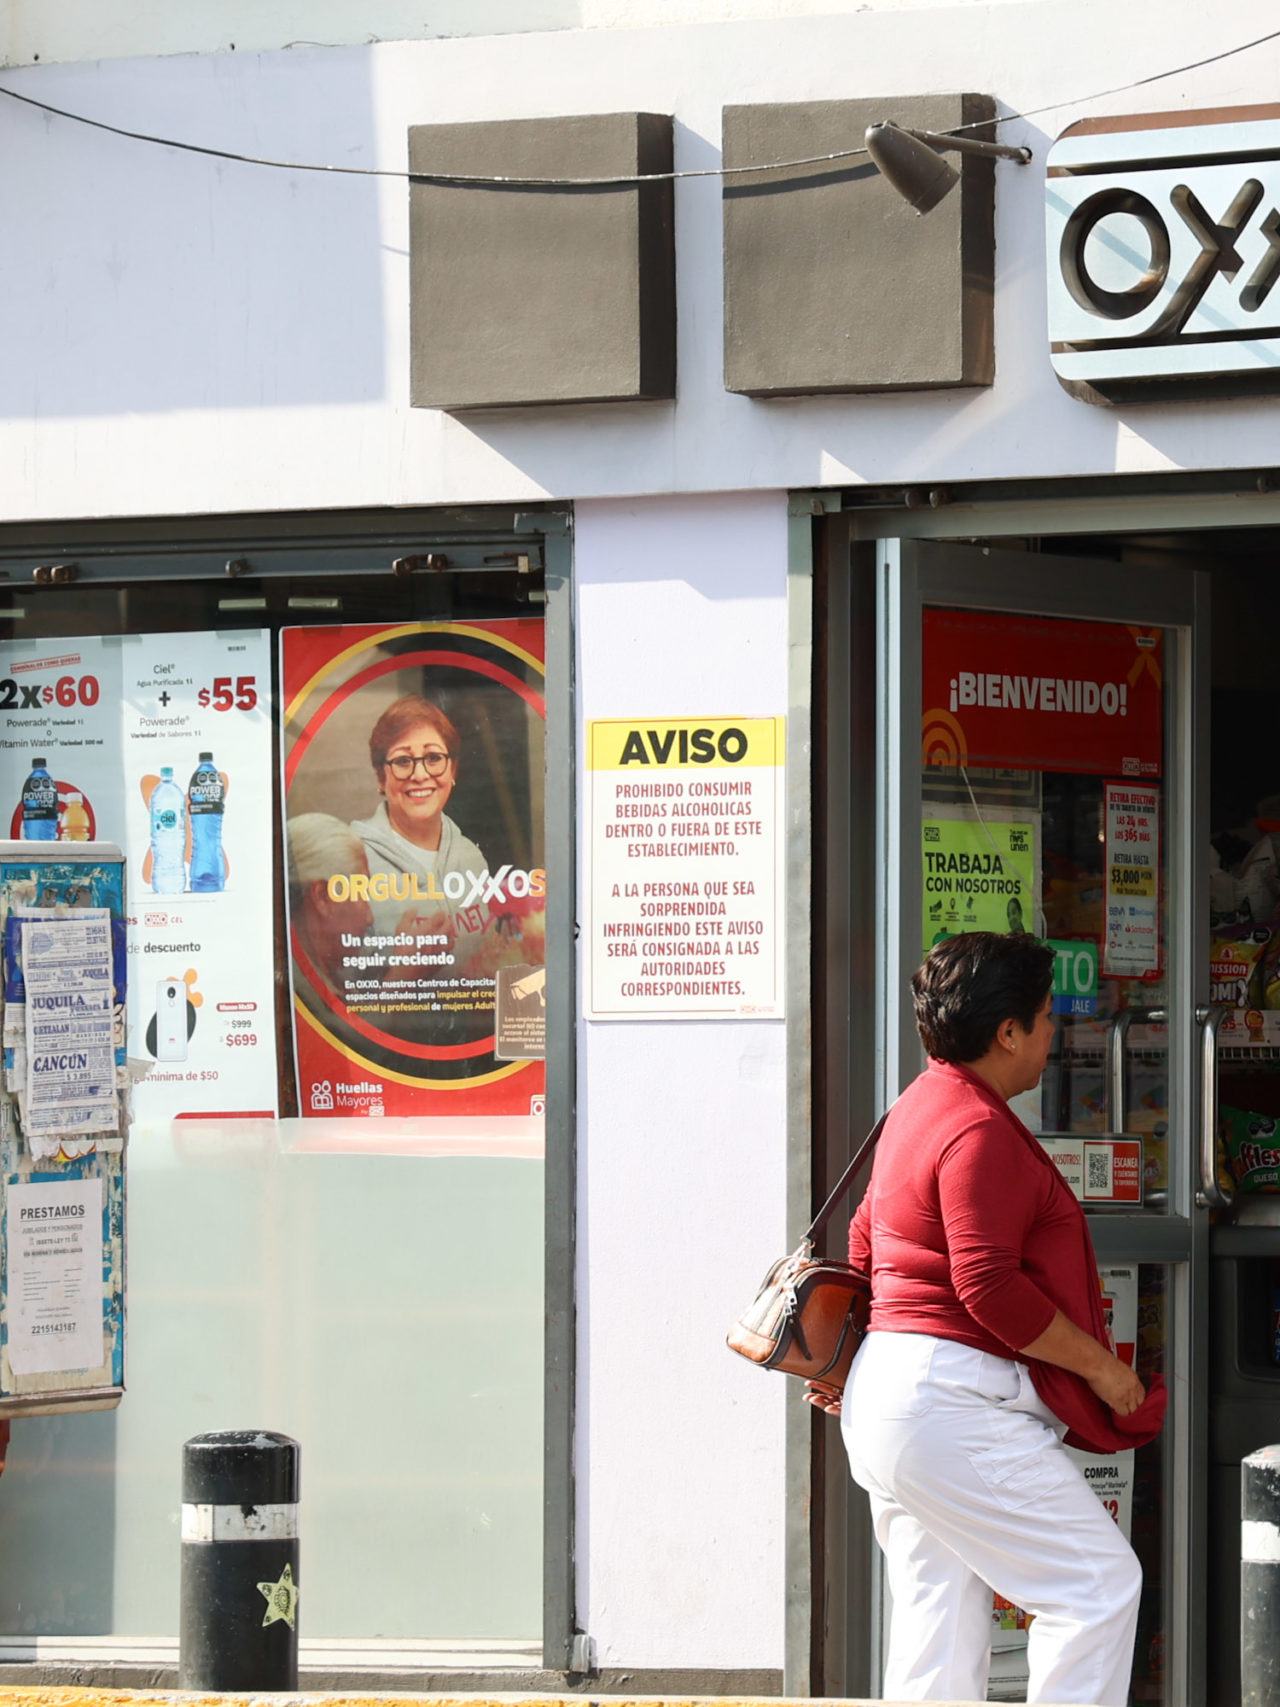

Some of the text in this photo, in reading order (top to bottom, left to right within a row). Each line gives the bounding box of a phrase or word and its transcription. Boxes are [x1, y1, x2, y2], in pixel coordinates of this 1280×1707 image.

[198, 676, 257, 711] $55
[949, 671, 1128, 717] ¡BIENVENIDO!
[619, 728, 748, 765] AVISO
[616, 781, 752, 798] PROHIBIDO CONSUMIR
[1109, 792, 1156, 806] RETIRA EFECTIVO
[616, 801, 752, 818] BEBIDAS ALCOHOLICAS
[161, 812, 176, 824] ciel
[606, 821, 762, 838] DENTRO O FUERA DE ESTE
[1124, 828, 1138, 842] 365
[628, 841, 739, 858] ESTABLECIMIENTO.
[925, 852, 1003, 875] TRABAJA
[1113, 853, 1149, 865] RETIRA HASTA
[1111, 868, 1139, 885] $3,000
[611, 881, 755, 899] A LA PERSONA QUE SEA
[926, 877, 1021, 895] CON NOSOTROS
[640, 901, 726, 917] SORPRENDIDA
[603, 920, 764, 938] INFRINGIENDO ESTE AVISO
[144, 942, 201, 953] descuento
[341, 932, 448, 949] Un espacio para
[607, 939, 760, 957] SERÁ CONSIGNADA A LAS
[342, 951, 455, 970] seguir creciendo
[641, 961, 725, 977] AUTORIDADES
[344, 980, 355, 989] En
[382, 980, 417, 989] nuestros
[417, 978, 449, 988] Centros
[449, 978, 459, 987] de
[621, 981, 746, 997] CORRESPONDIENTES.
[32, 994, 86, 1010] JUQUILA
[345, 991, 378, 1001] espacios
[418, 991, 436, 1001] para
[437, 990, 470, 1000] impulsar
[346, 1004, 380, 1014] personal
[387, 1003, 431, 1013] profesional
[431, 1002, 441, 1011] de
[442, 1002, 474, 1012] mujeres
[1070, 1000, 1091, 1013] JALE
[231, 1020, 252, 1029] $999
[226, 1034, 257, 1046] $699
[186, 1071, 198, 1081] de
[200, 1071, 219, 1081] $50
[336, 1082, 383, 1094] Huellas
[337, 1095, 384, 1109] Mayores
[1253, 1172, 1278, 1184] QUESO
[20, 1205, 86, 1220] PRESTAMOS
[1084, 1467, 1119, 1479] COMPRA
